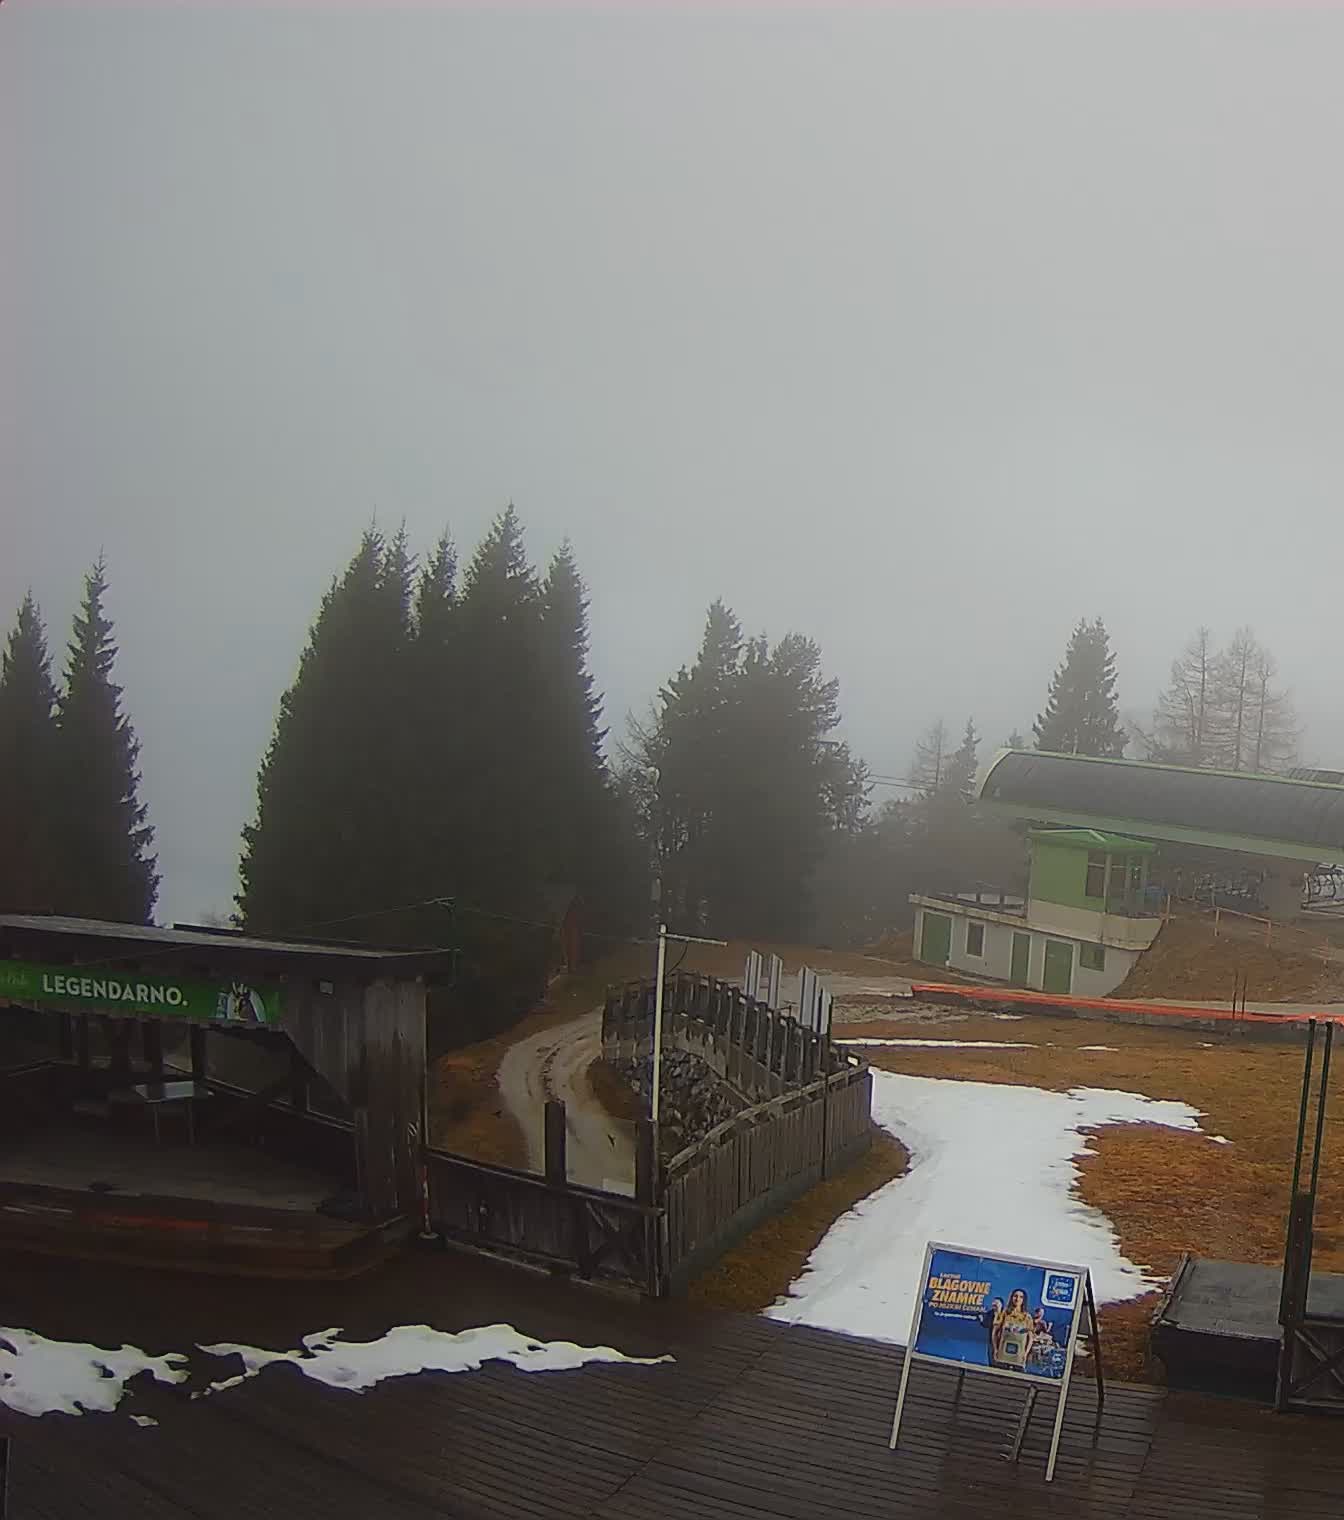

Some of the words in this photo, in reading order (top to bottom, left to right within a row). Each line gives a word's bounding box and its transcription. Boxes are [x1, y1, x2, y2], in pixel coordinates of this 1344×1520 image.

[43, 974, 189, 1006] LEGENDARNO.
[929, 1276, 991, 1295] BLAGOVNE
[931, 1290, 985, 1306] ZNAMKE
